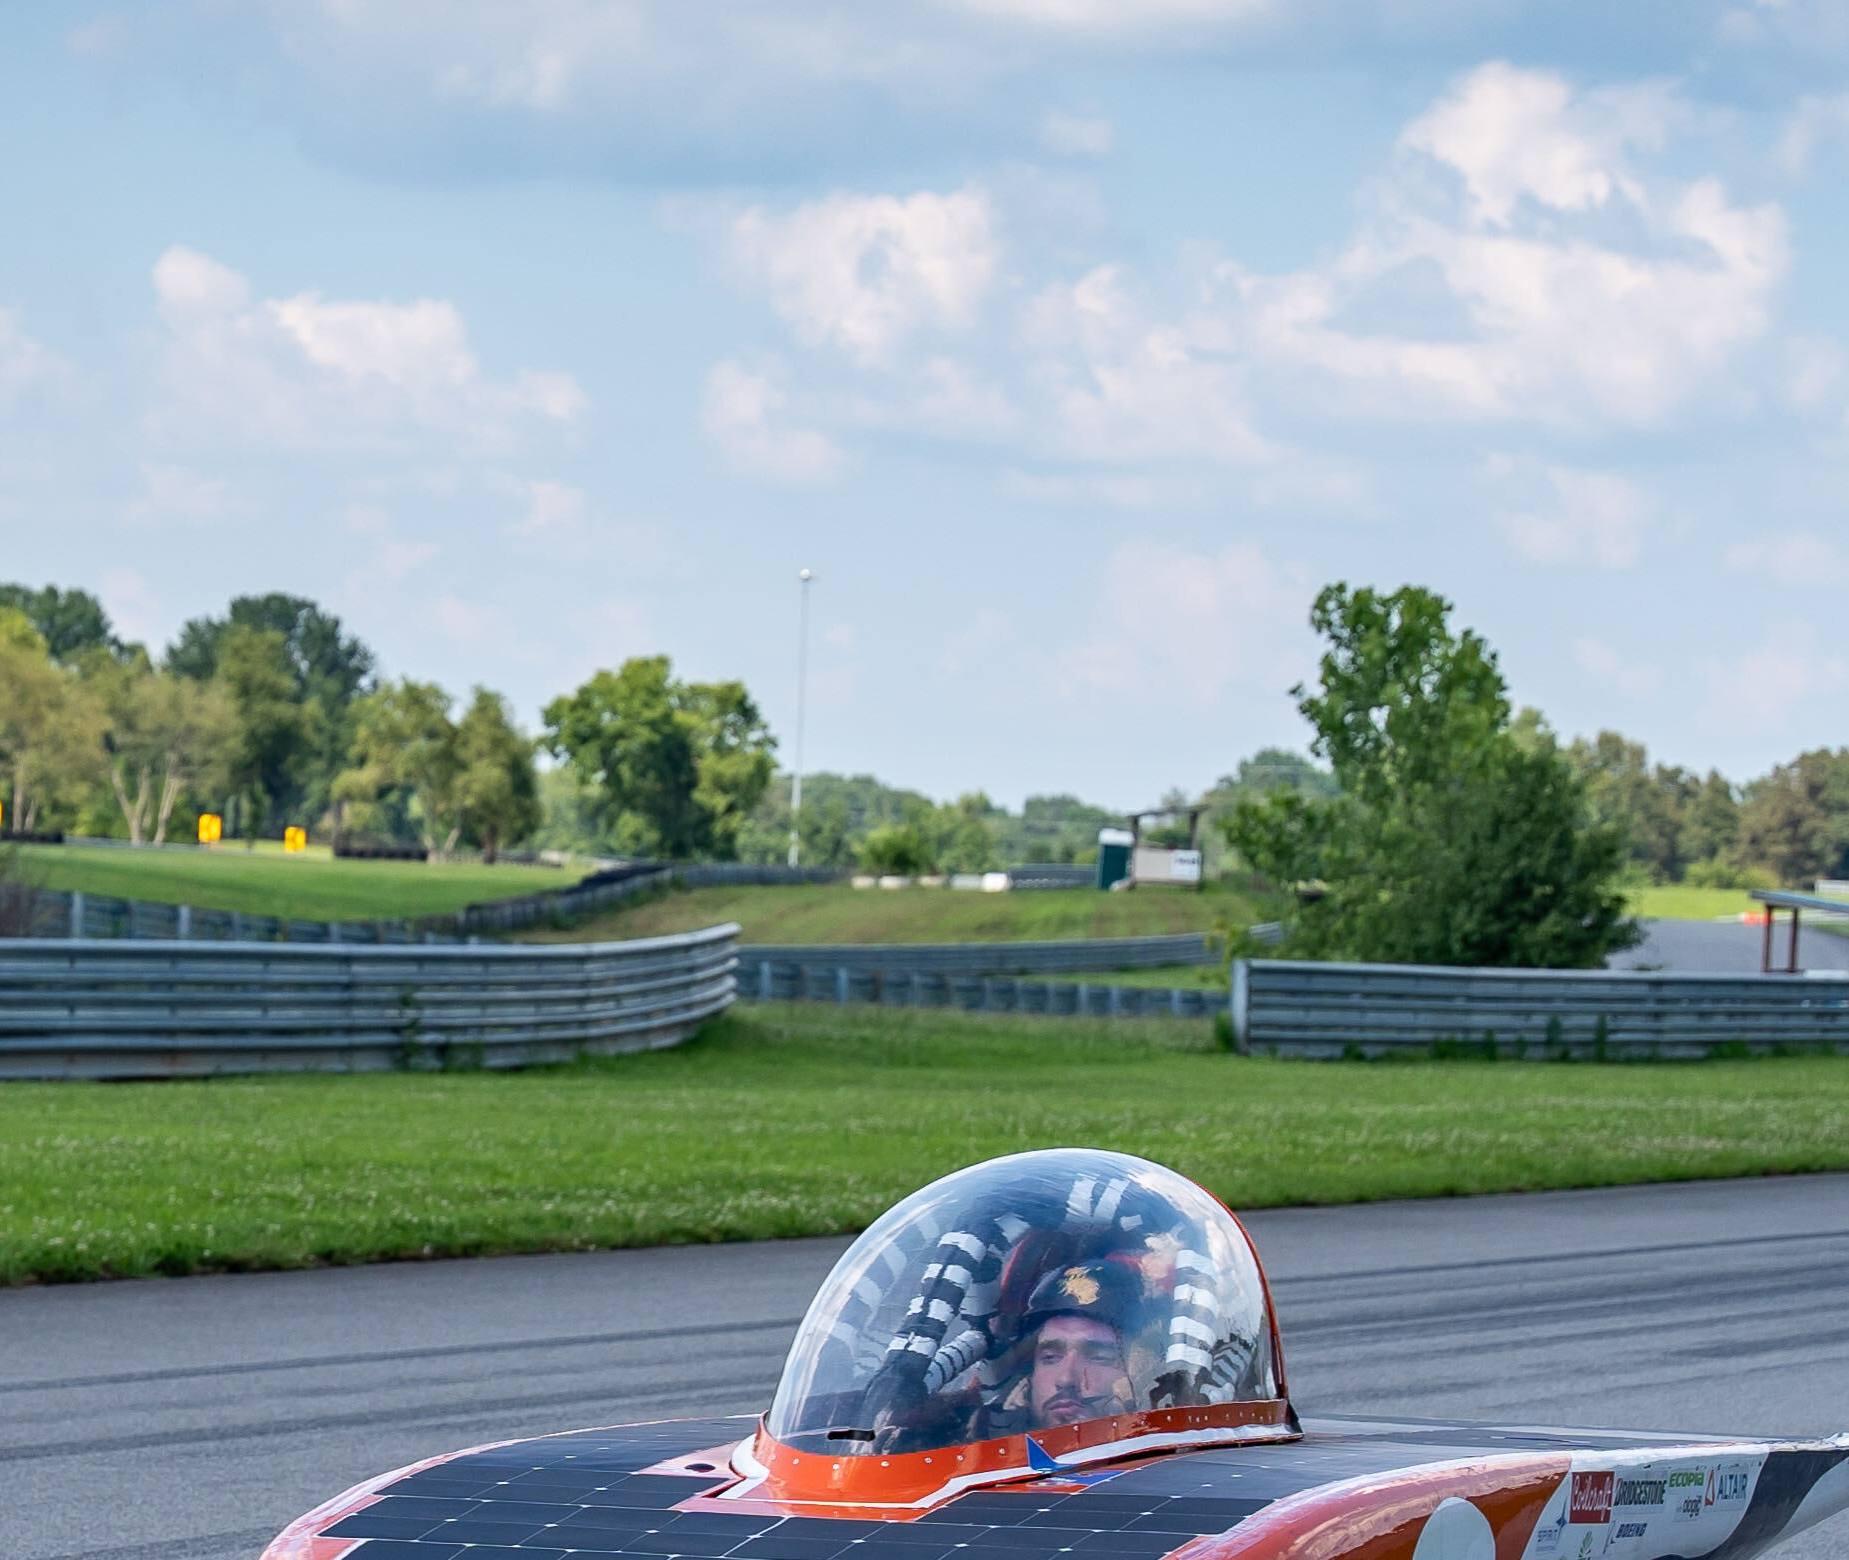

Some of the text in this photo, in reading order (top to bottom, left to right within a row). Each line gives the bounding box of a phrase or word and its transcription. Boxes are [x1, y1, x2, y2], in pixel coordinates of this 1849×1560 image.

[1572, 1475, 1612, 1522] Coilcraft
[1614, 1478, 1667, 1506] BRIDGESTONE
[1717, 1474, 1748, 1500] ALTAIR
[1616, 1523, 1647, 1538] BOEING
